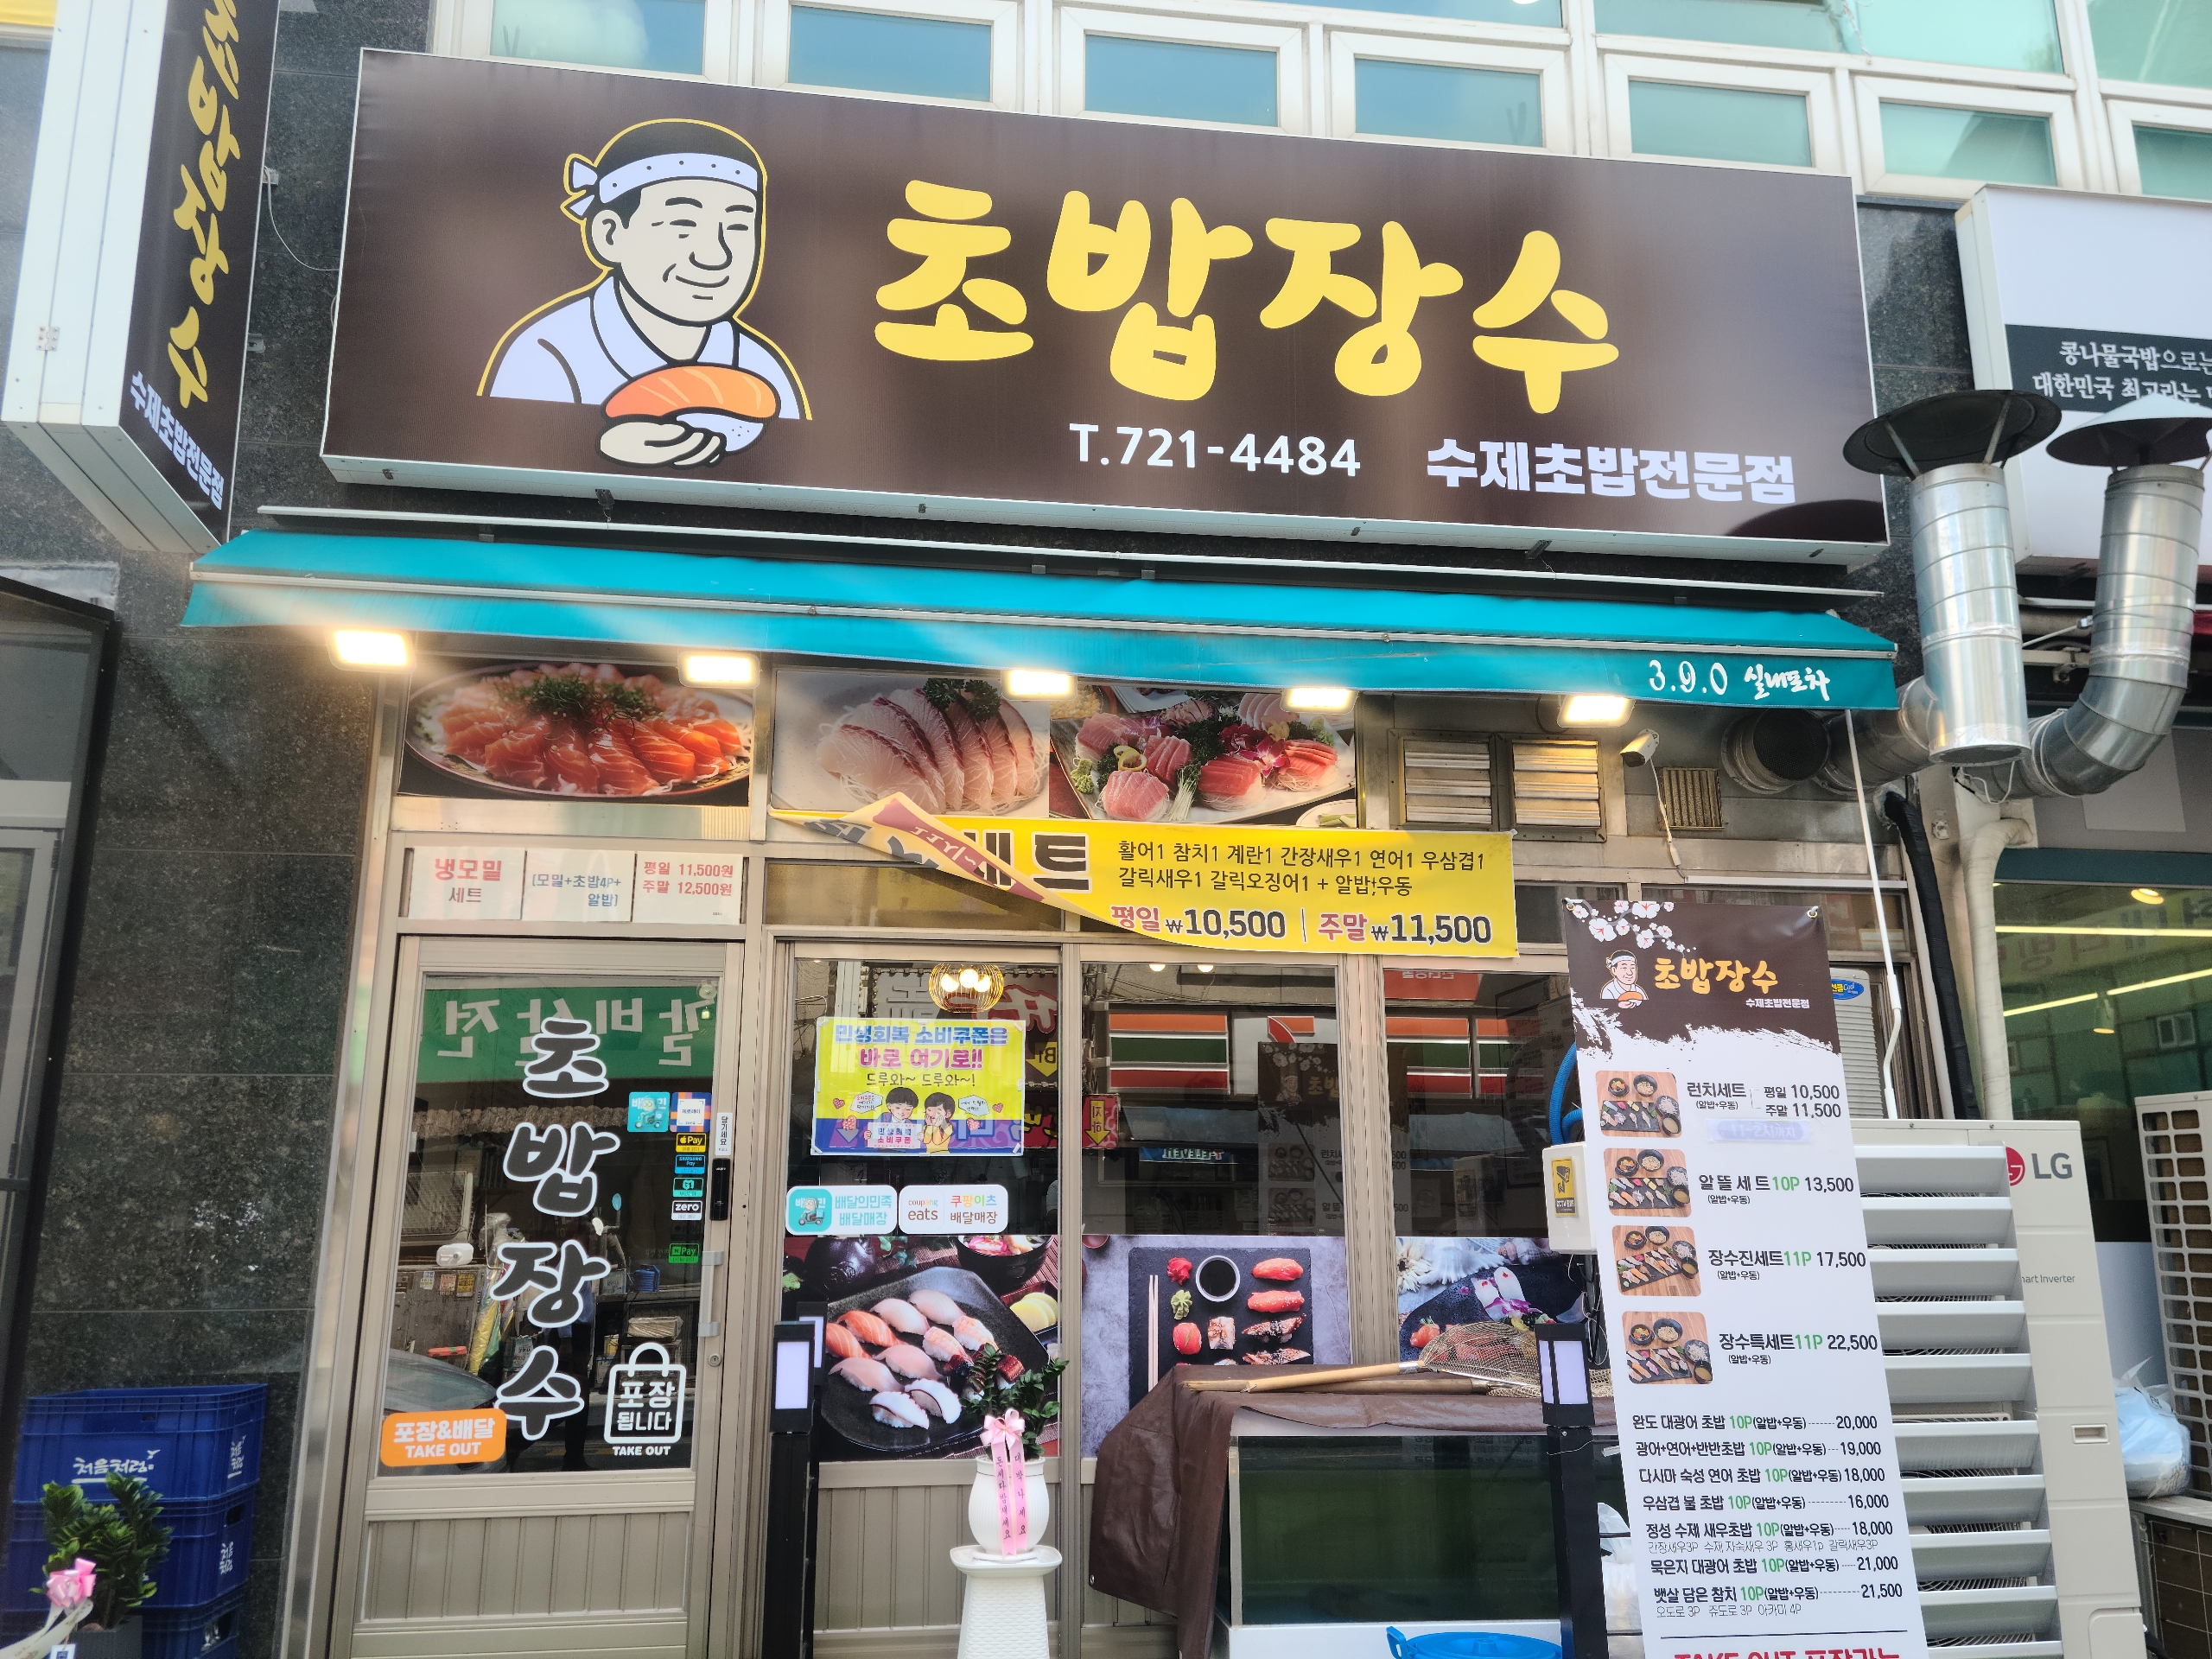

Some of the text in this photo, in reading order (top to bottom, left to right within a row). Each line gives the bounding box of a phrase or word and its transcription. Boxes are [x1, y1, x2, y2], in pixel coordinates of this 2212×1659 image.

[874, 179, 1620, 414] 초밥장수
[2032, 372, 2114, 401] 대한민국
[130, 371, 225, 511] 수제초밥전문점
[1070, 423, 1361, 477] T.721-4484
[1427, 438, 1796, 505] 수제초밥전문점
[1649, 659, 1831, 701] 3.9.0 실내포차
[1118, 841, 1484, 871] 활어1 참치1 계란1 간장새우1 연어1 우삼겹1
[434, 859, 502, 882] 냉모밀
[644, 861, 734, 878] 평일 11,500원
[642, 880, 733, 896] 주말 12,500원
[1119, 867, 1201, 889] 갈릭새우1
[1211, 870, 1308, 893] 갈릭오징어1
[448, 887, 482, 904] 세트
[1111, 906, 1161, 933] 평일
[1319, 913, 1367, 942] 주말
[1654, 957, 1778, 995] 초밥장수
[1745, 997, 1810, 1009] 수제초밥전문점
[835, 1024, 1008, 1046] 민생회복 소비쿠폰은
[859, 1048, 983, 1070] 바로 여기로!!
[1687, 1083, 1746, 1097] 런치세트
[1764, 1084, 1840, 1100] 평일 10,500
[1765, 1103, 1841, 1118] 주말 11,500
[720, 1116, 728, 1146] 당기세요
[688, 1136, 702, 1146] Pay
[2031, 1153, 2073, 1179] LG
[1804, 1176, 1854, 1192] 13,500
[675, 1203, 700, 1211] zero
[835, 1195, 893, 1209] 배달의민족
[950, 1194, 997, 1208] 쿠팡이츠
[839, 1211, 887, 1226] 배달매장
[908, 1208, 938, 1221] eats
[950, 1211, 998, 1224] 배달매장
[490, 1018, 620, 1440] 초밥장수
[682, 1248, 696, 1256] Pay
[1816, 1252, 1866, 1267] 17,500
[2022, 1274, 2075, 1283] art Inverter
[1827, 1335, 1878, 1350] 22,500
[618, 1382, 675, 1408] 포장
[617, 1411, 671, 1431] 됩니다
[1632, 1415, 1658, 1430] 완도
[1660, 1415, 1698, 1430] 대광어
[1701, 1414, 1726, 1430] 초밥
[1835, 1415, 1878, 1430] 20,000
[393, 1418, 495, 1443] 포장&배달
[405, 1441, 481, 1459] TAKE OUT
[613, 1446, 671, 1456] TAKE OUT
[1636, 1441, 1745, 1457] 광어+연어+반반초밥
[1840, 1441, 1881, 1456] 19,000
[73, 1456, 148, 1476] 처음처럼
[1639, 1469, 1677, 1484] 다시마
[1681, 1469, 1705, 1484] 숙성
[1708, 1469, 1733, 1484] 연어
[1737, 1468, 1761, 1484] 초밥
[1844, 1467, 1885, 1483] 18,000
[1643, 1495, 1681, 1510] 우삼겹
[1683, 1496, 1696, 1510] 불
[1700, 1495, 1724, 1510] 초밥
[1848, 1494, 1890, 1509] 16,000
[1645, 1522, 1671, 1539] 정성
[1675, 1522, 1700, 1538] 수제
[1703, 1522, 1752, 1538] 새우초밥
[1852, 1521, 1893, 1536] 18,000
[1650, 1559, 1688, 1575] 묵은지
[1691, 1558, 1730, 1574] 대광어
[1732, 1558, 1758, 1573] 초밥
[1857, 1555, 1898, 1572] 21,000
[1681, 1586, 1708, 1604] 담은
[1711, 1586, 1738, 1602] 참치
[1860, 1583, 1903, 1599] 21,500
[1656, 1605, 1686, 1618] 오도로
[1688, 1605, 1700, 1618] 3P
[1740, 1605, 1752, 1616] 3P
[1758, 1604, 1788, 1616] 아카미
[1789, 1603, 1802, 1615] 4P
